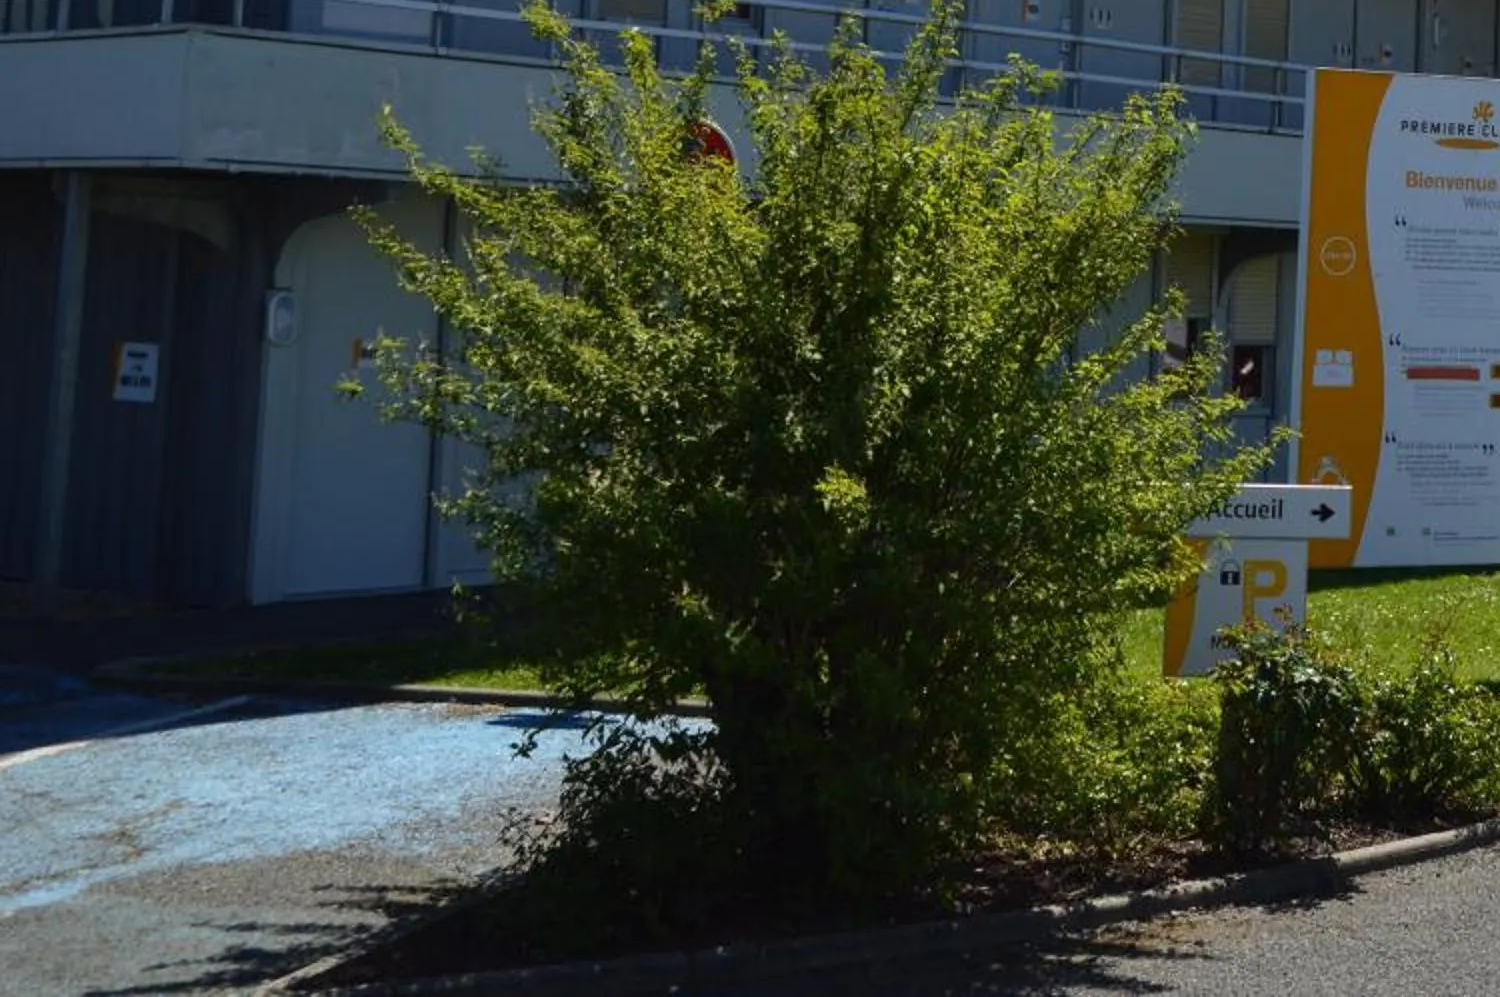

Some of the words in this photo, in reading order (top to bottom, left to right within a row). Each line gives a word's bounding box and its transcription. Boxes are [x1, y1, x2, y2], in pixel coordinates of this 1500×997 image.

[1401, 120, 1475, 136] PREMIERE
[1406, 170, 1498, 192] Bienvenue
[1209, 498, 1283, 520] Accueil
[1241, 559, 1288, 627] P
